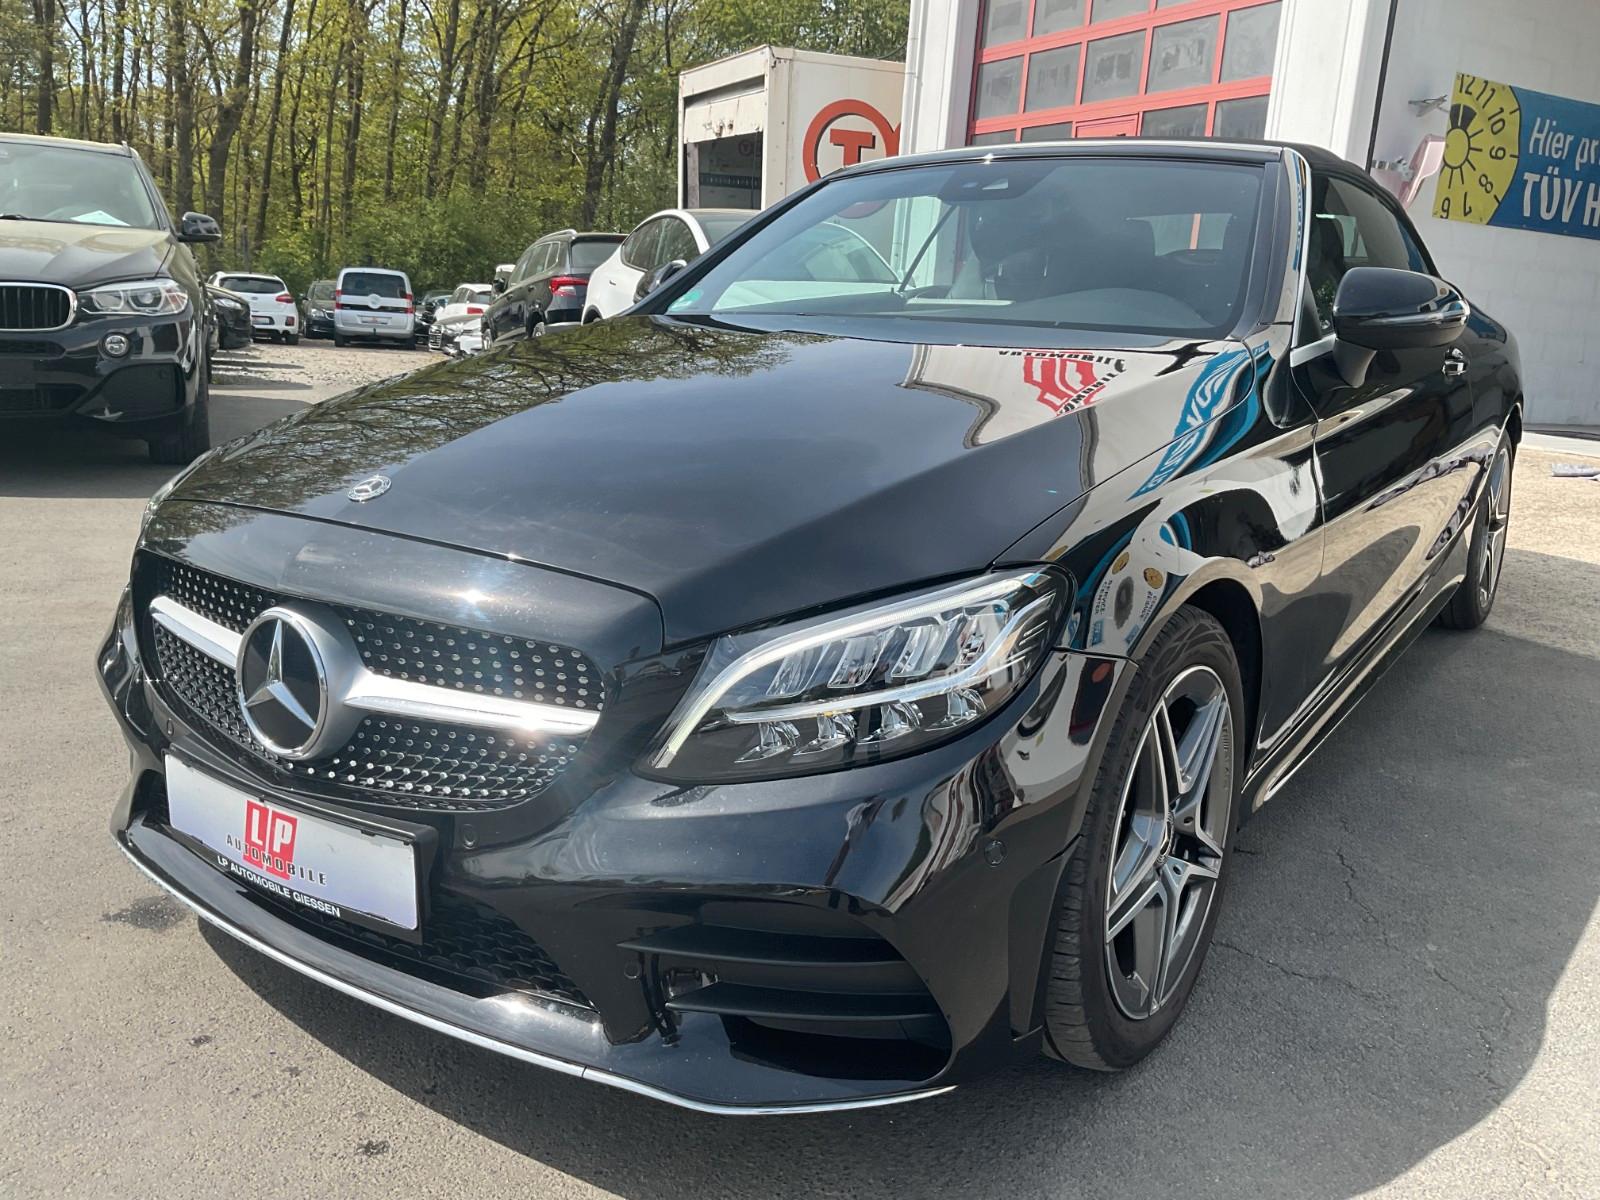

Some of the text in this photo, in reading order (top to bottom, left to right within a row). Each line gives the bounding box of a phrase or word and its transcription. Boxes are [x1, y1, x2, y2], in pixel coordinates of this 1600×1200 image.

[1458, 73, 1476, 96] 12
[1476, 80, 1496, 109] 11
[1487, 107, 1506, 136] 10
[1528, 117, 1600, 172] Hier pr
[1478, 173, 1494, 194] 8
[1523, 166, 1584, 223] TÜV
[251, 808, 293, 853] LP
[226, 834, 327, 886] AUTOMOBILE
[217, 855, 341, 918] LP AUTOMOBILE GIESSEN
